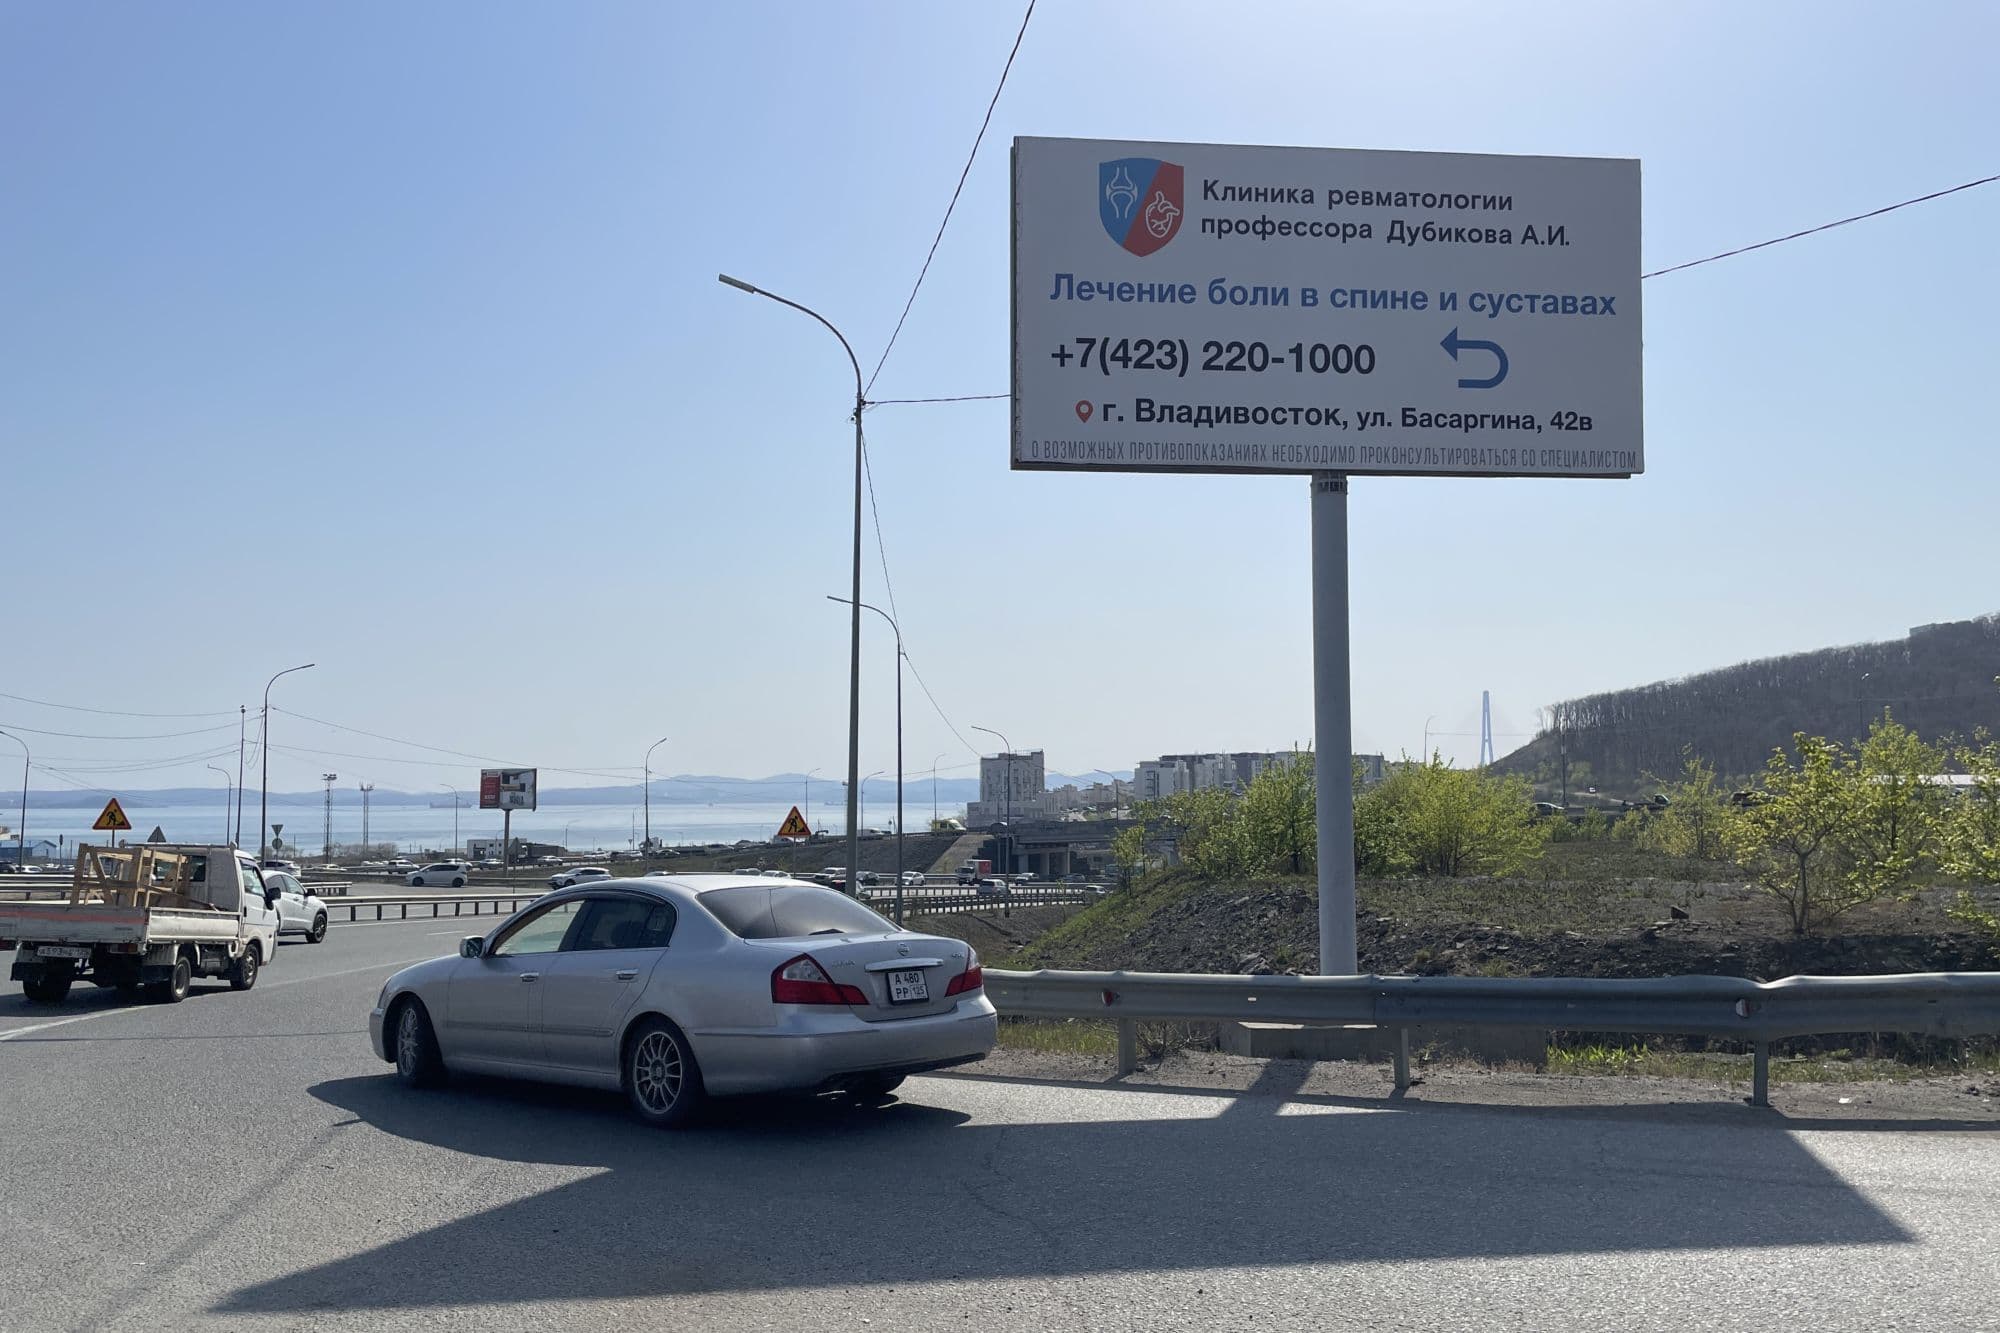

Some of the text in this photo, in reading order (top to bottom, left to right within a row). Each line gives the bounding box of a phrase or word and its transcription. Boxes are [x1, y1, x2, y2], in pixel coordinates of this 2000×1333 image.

[1203, 179, 1513, 211] Клиника ревматологии
[1202, 215, 1570, 247] профессора Дубикова А.И.
[1049, 273, 1617, 319] Лечение боли в спине и суставах
[1051, 336, 1376, 378] +7(423) 220-1000
[1102, 398, 1593, 434] г. Владивосток, ул. Басаргина, 42в
[1031, 441, 1636, 470] О ВОЗМОЖНЫХ ПРОТИВОПОКАЗАНИЯХ НЕОБХОДИМО ПРОКОНСУЛЬТИРОВАТЬСЯ СО СПЕЦИАЛИСТОМ
[895, 972, 920, 985] А 480
[895, 987, 909, 999] РР
